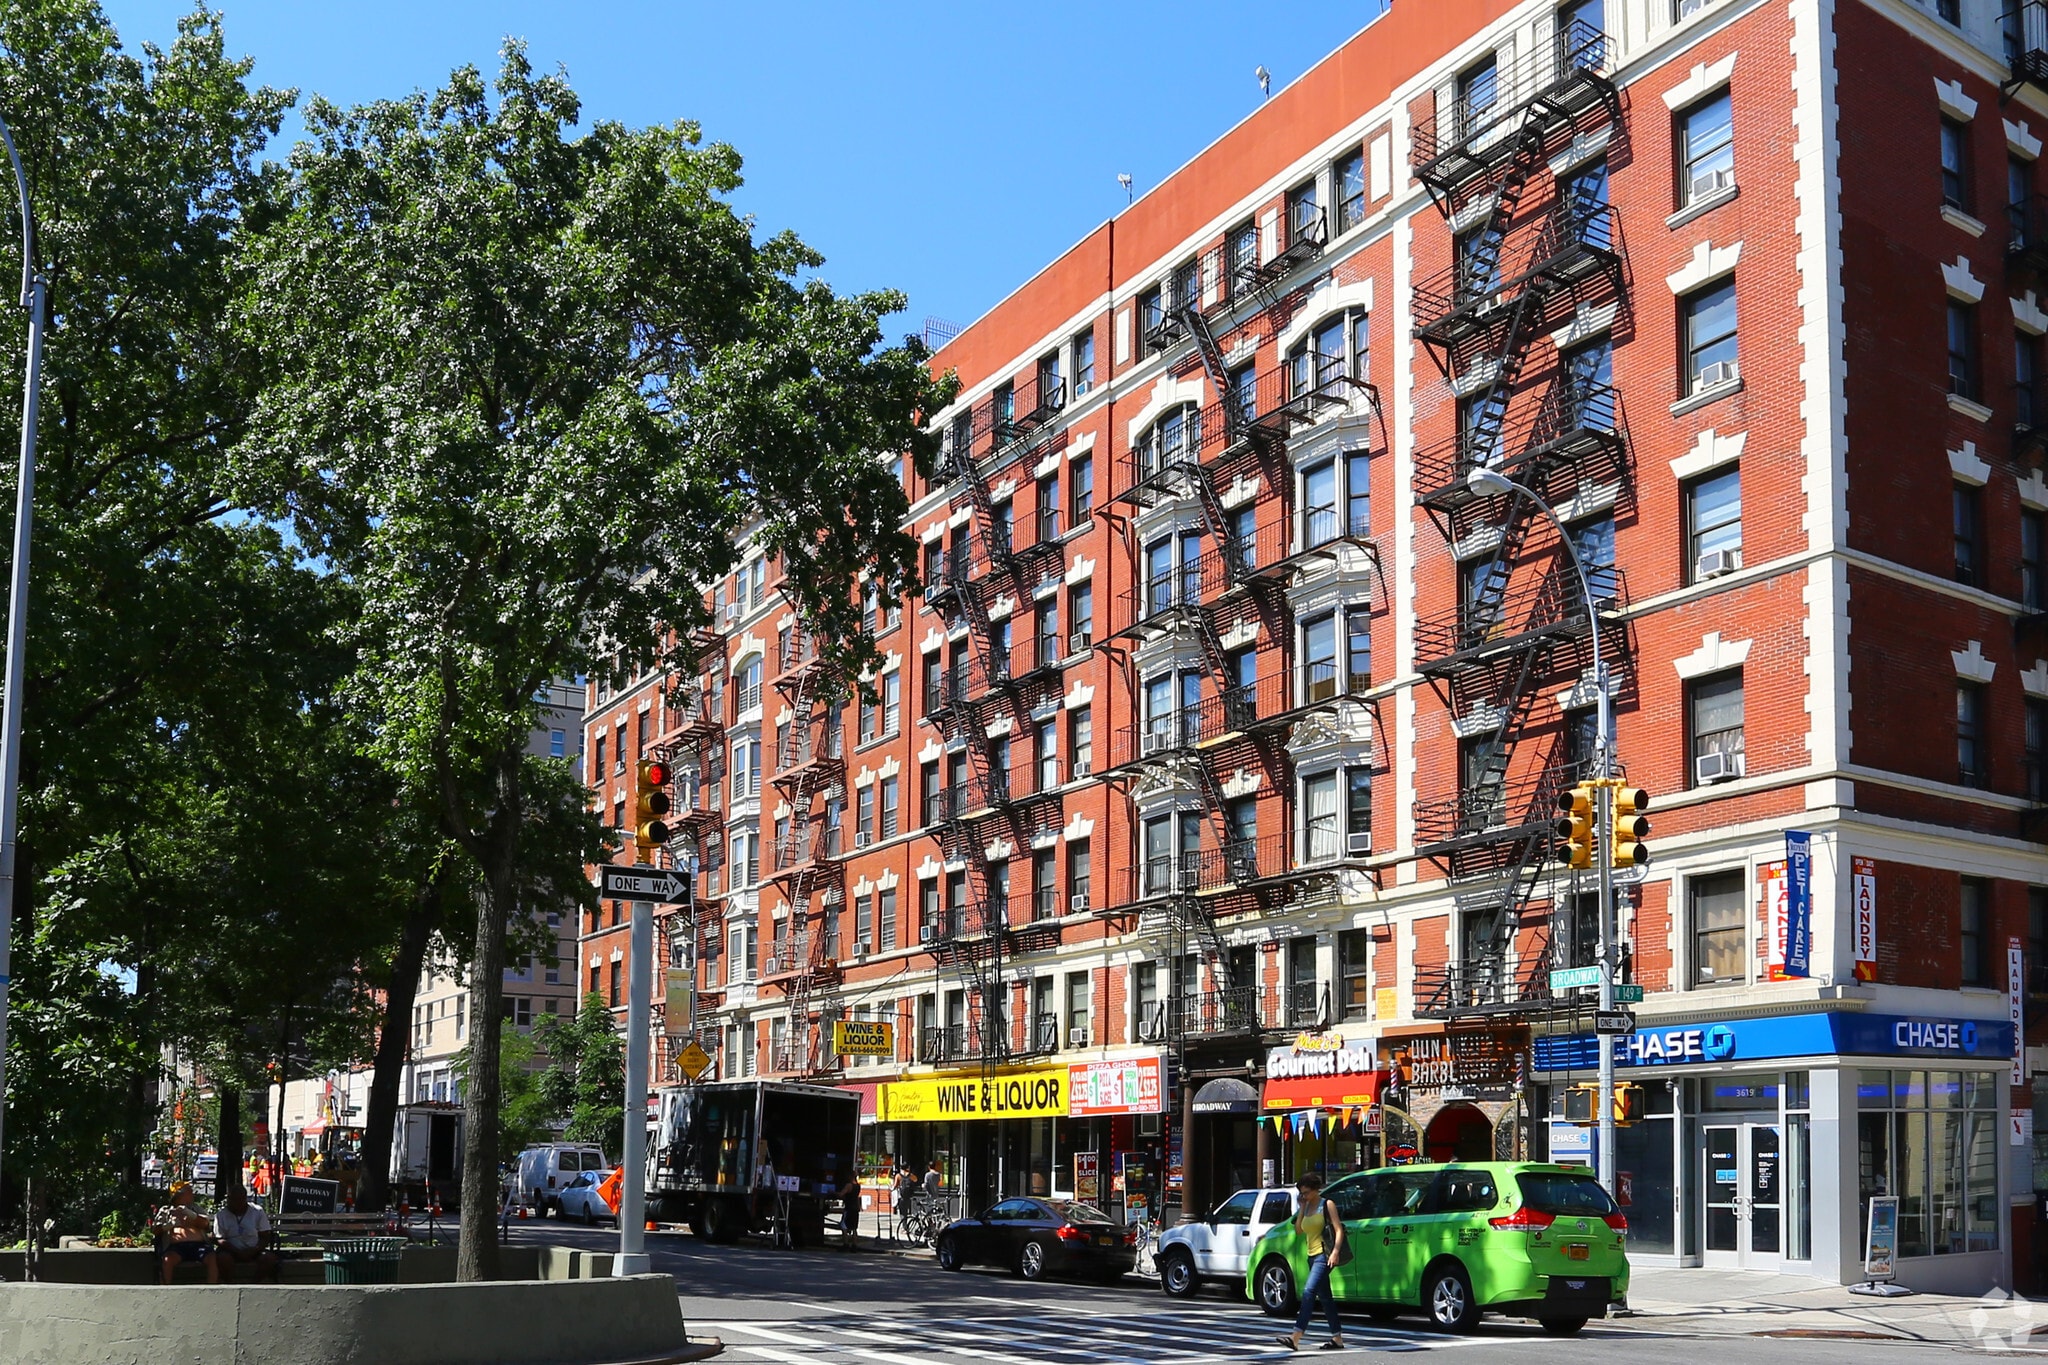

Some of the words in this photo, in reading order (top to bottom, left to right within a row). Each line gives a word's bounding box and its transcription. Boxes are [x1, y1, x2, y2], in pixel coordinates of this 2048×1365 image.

[1794, 854, 1807, 895] PET
[615, 877, 641, 891] ONE
[652, 880, 678, 894] WAY
[1859, 876, 1871, 959] LAUNDRY
[1794, 902, 1805, 958] CARE
[1552, 968, 1598, 988] BROADWAY
[1622, 987, 1634, 1000] 149
[845, 1023, 873, 1034] WINE
[876, 1024, 884, 1034] &
[1601, 1018, 1612, 1027] ONE
[1617, 1019, 1630, 1028] WAY
[844, 1035, 885, 1046] LIQUOR
[1291, 1031, 1332, 1055] Moe's
[1896, 1022, 1960, 1049] CHASE
[1087, 1062, 1111, 1071] PIZZA
[1112, 1060, 1137, 1069] GHOR
[1267, 1052, 1335, 1078] Gourmet
[1336, 1046, 1373, 1073] Deli
[937, 1084, 976, 1113] WINE
[981, 1083, 992, 1112] &
[996, 1079, 1060, 1111] LIQUOR
[1736, 1088, 1755, 1097] 3619
[1552, 1134, 1580, 1144] CHASE
[290, 1186, 331, 1197] BROADWAY
[296, 1199, 322, 1207] MALLS
